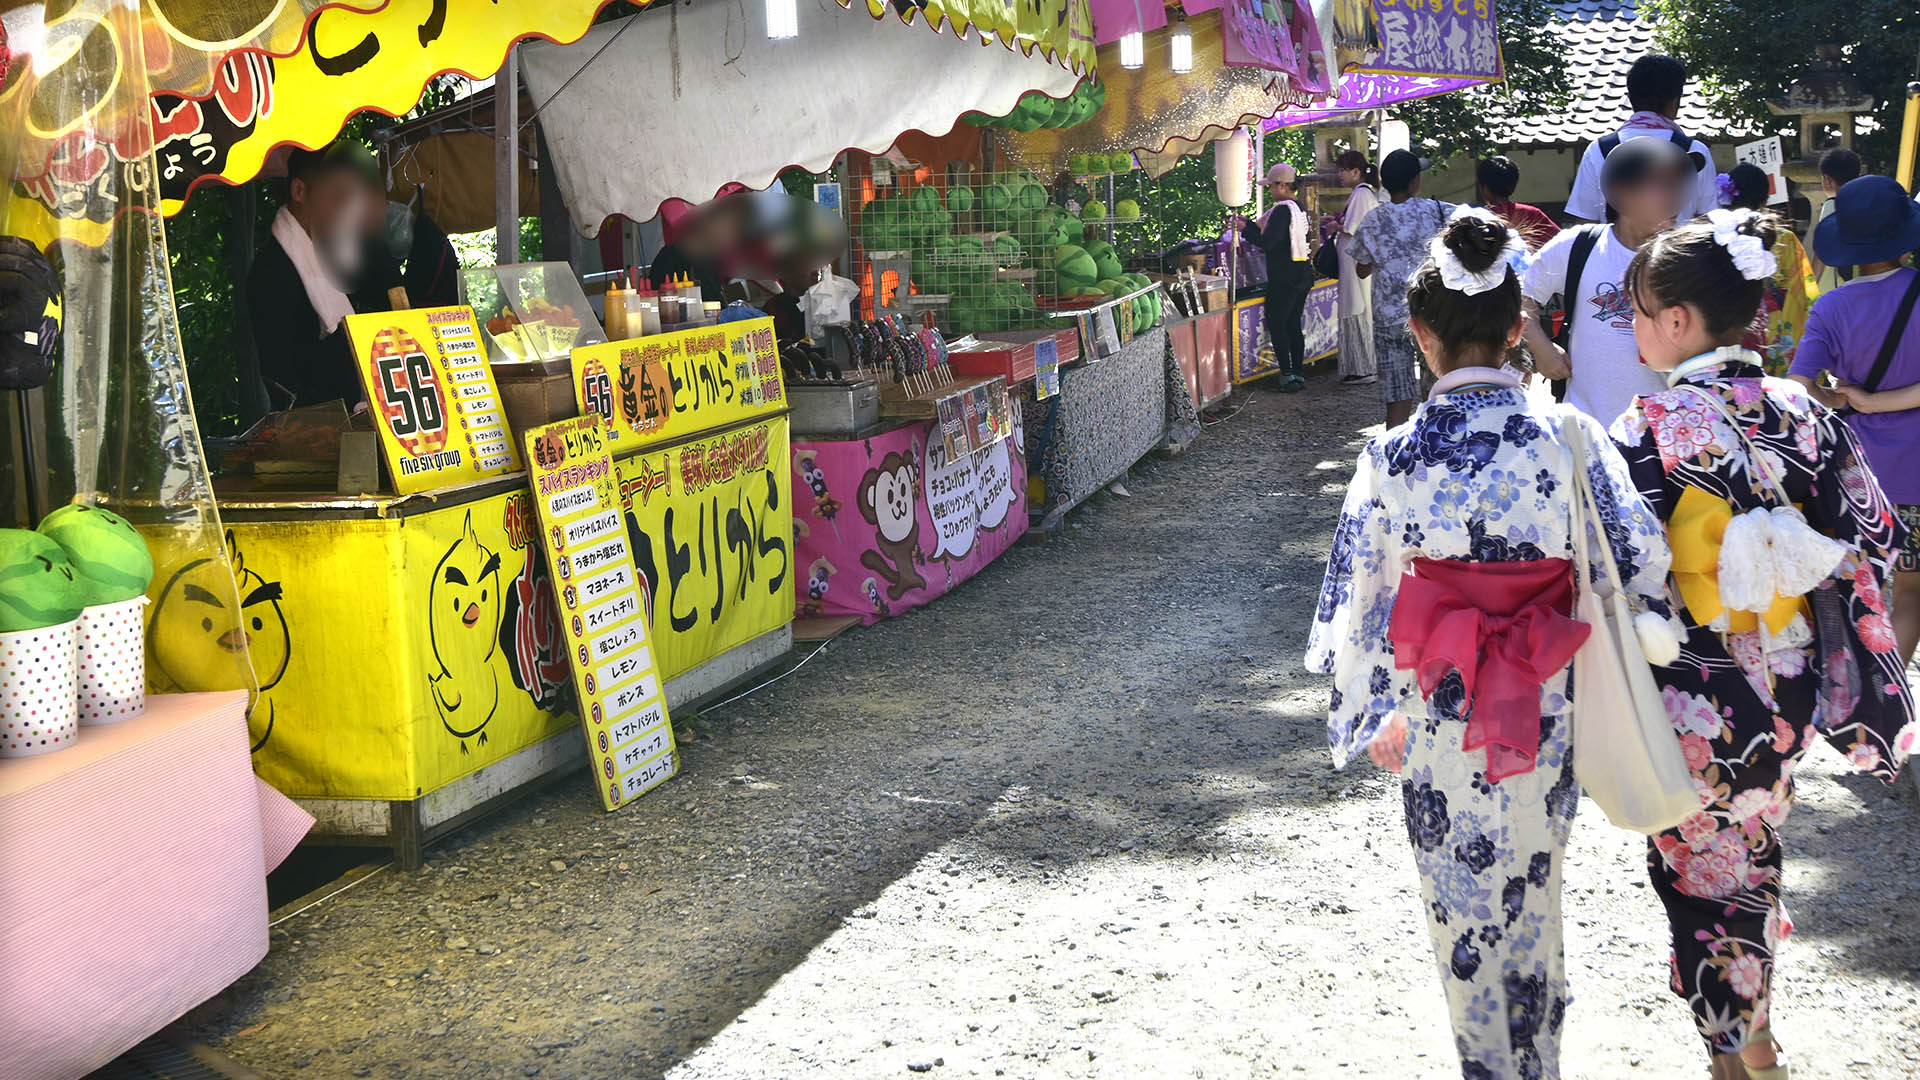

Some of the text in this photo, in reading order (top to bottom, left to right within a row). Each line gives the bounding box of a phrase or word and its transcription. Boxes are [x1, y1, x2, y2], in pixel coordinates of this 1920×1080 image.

[377, 353, 443, 438] 56
[472, 401, 488, 410] レモン
[585, 373, 612, 420] 56
[399, 456, 420, 475] five
[420, 453, 434, 472] six
[434, 449, 461, 471] group
[538, 455, 609, 496] スパイスランキング
[569, 515, 617, 541] オリジナルスパイス
[575, 542, 624, 569] うまから塩だれ
[663, 468, 788, 633] とりから
[586, 571, 624, 595] マヨネーズ
[589, 598, 634, 626] スイートチリ
[599, 628, 637, 654] 塩こしょう
[611, 659, 637, 679] レモン
[615, 709, 660, 742] トマトバジル
[627, 758, 669, 791] チョコレート
